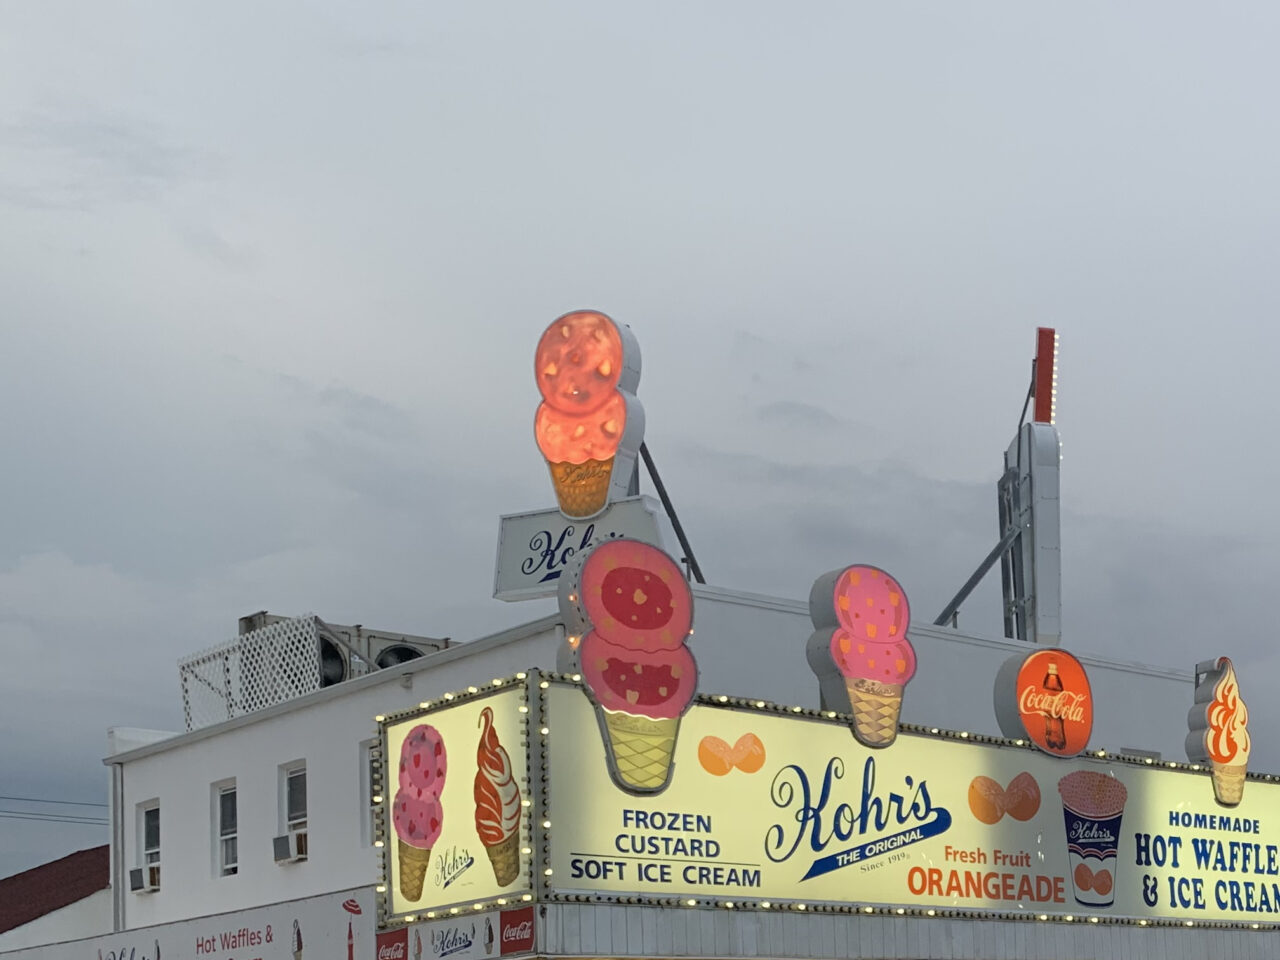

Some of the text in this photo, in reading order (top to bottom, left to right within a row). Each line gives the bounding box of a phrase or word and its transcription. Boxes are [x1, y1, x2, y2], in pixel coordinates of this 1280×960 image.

[622, 809, 712, 833] FROZEN
[764, 756, 934, 863] Kohr's
[1169, 811, 1260, 834] HOMEMADE
[615, 834, 721, 858] CUSTARD
[836, 828, 924, 867] THE ORIGINAL
[945, 846, 1031, 868] Fresh Fruit
[1135, 833, 1182, 868] HOT
[570, 859, 761, 887] SOFT ICE CREAM
[860, 852, 906, 874] Since 1919
[907, 867, 1066, 903] ORANGEADE
[1143, 874, 1158, 907] &
[1168, 876, 1206, 909] ICE
[196, 925, 273, 954] Hot Waffles &
